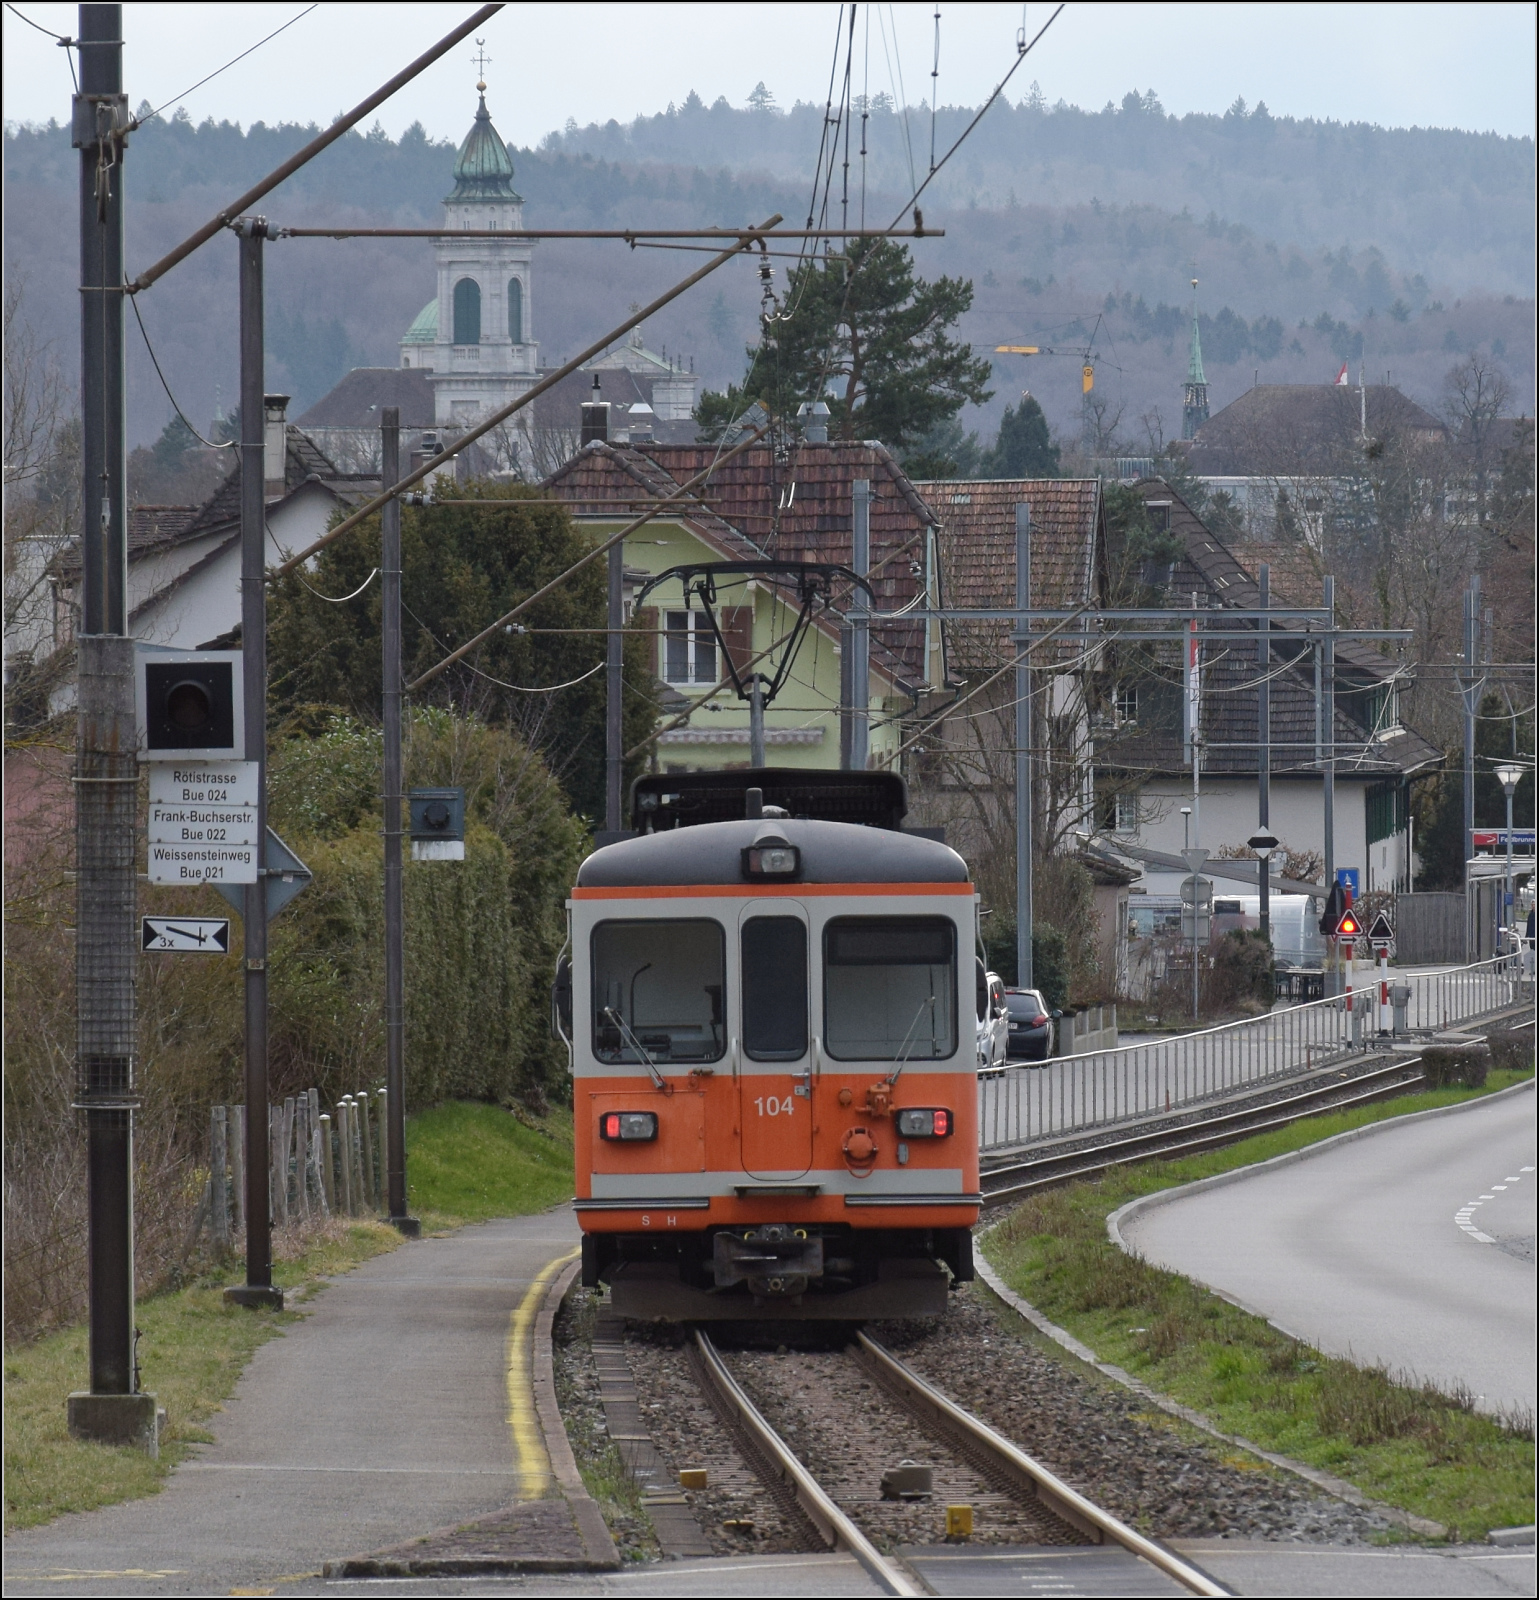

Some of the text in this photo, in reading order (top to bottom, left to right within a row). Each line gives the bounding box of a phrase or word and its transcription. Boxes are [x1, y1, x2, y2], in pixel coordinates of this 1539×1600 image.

[173, 770, 237, 784] Rötistrasse
[182, 788, 227, 801] Bue 024
[154, 809, 254, 823] Frank-Buchserstr.
[181, 828, 226, 840] Bue 022
[153, 848, 251, 864] Weissensteinweg
[180, 866, 224, 878] Bue 021
[160, 936, 174, 948] 3x
[754, 1095, 794, 1117] 104
[641, 1215, 676, 1226] S H
